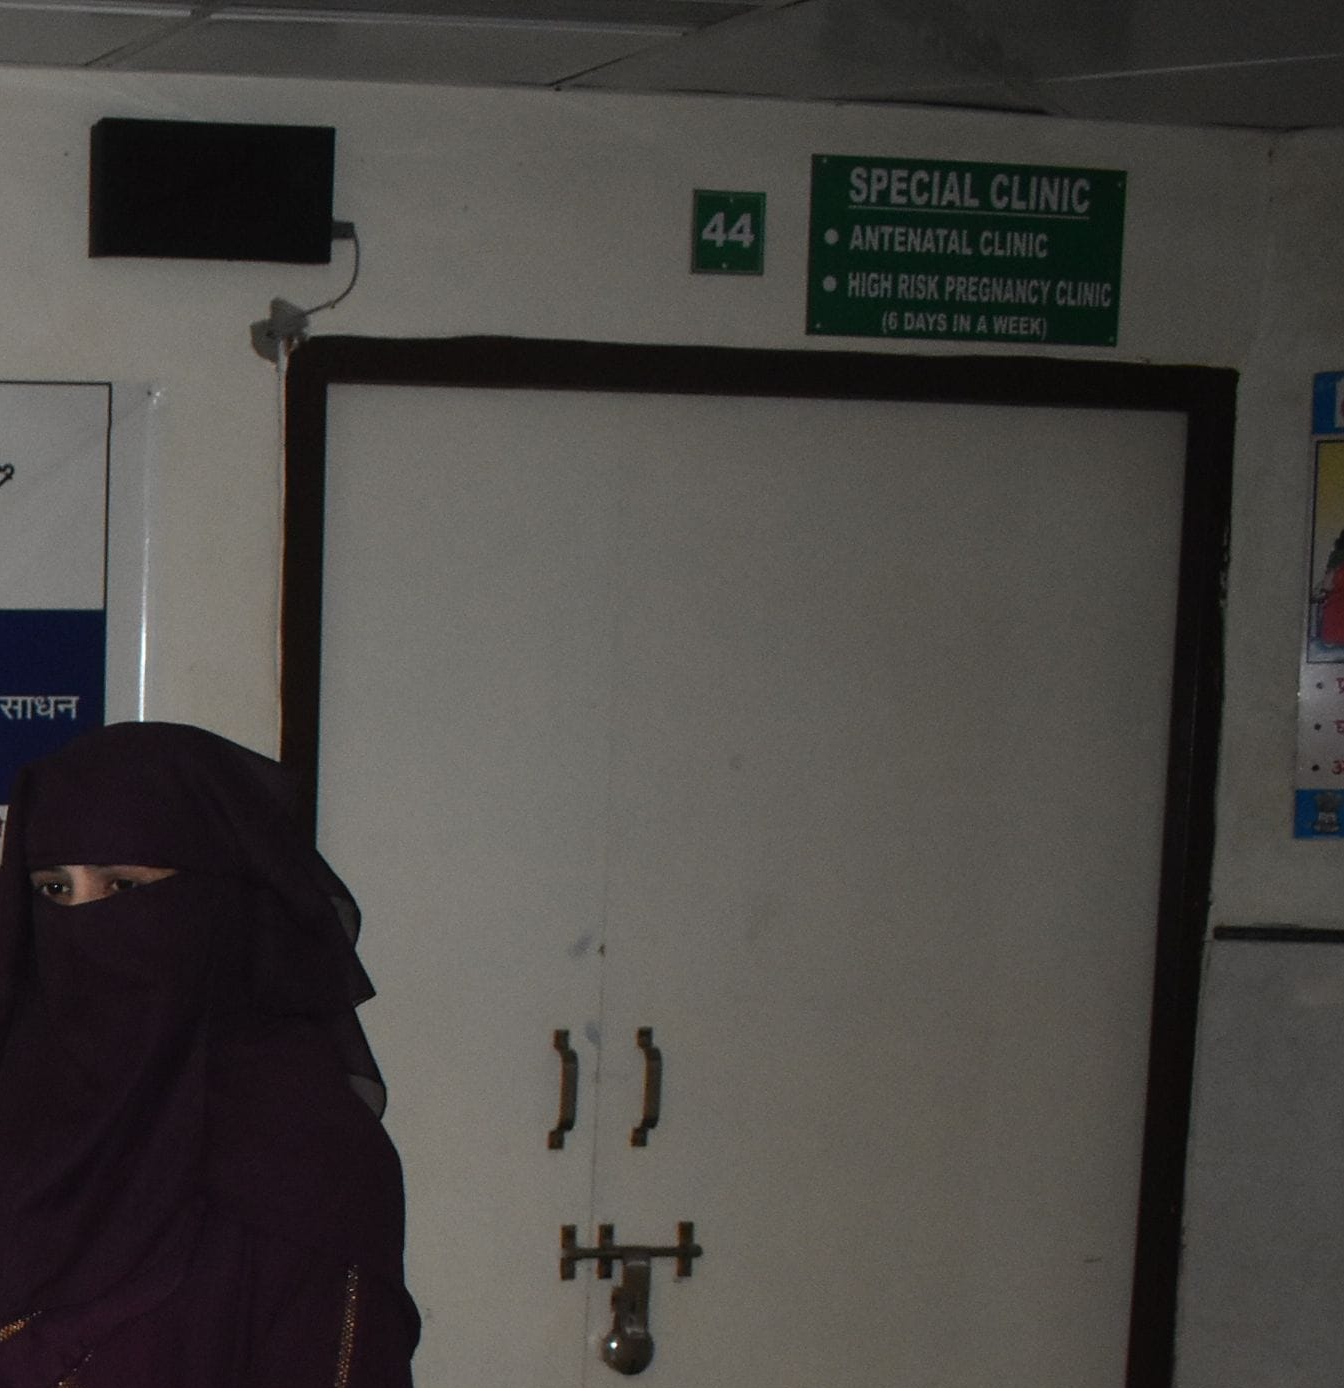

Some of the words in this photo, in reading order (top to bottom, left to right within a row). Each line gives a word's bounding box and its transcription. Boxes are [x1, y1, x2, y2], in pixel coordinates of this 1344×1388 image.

[849, 166, 981, 208] SPECIAL
[991, 174, 1091, 213] CLINIC
[700, 211, 755, 249] 44
[849, 225, 974, 257] ANTENATAL
[980, 231, 1049, 260] CLINIC
[847, 272, 894, 299] HIGH
[898, 274, 940, 301] RISK
[945, 276, 1051, 306] PREGNANCY
[1056, 281, 1112, 308] CLINIC
[882, 313, 899, 336] (6
[904, 313, 948, 334] DAYS
[953, 314, 972, 334] IN
[975, 316, 989, 335] A
[993, 315, 1048, 341] WEEK)
